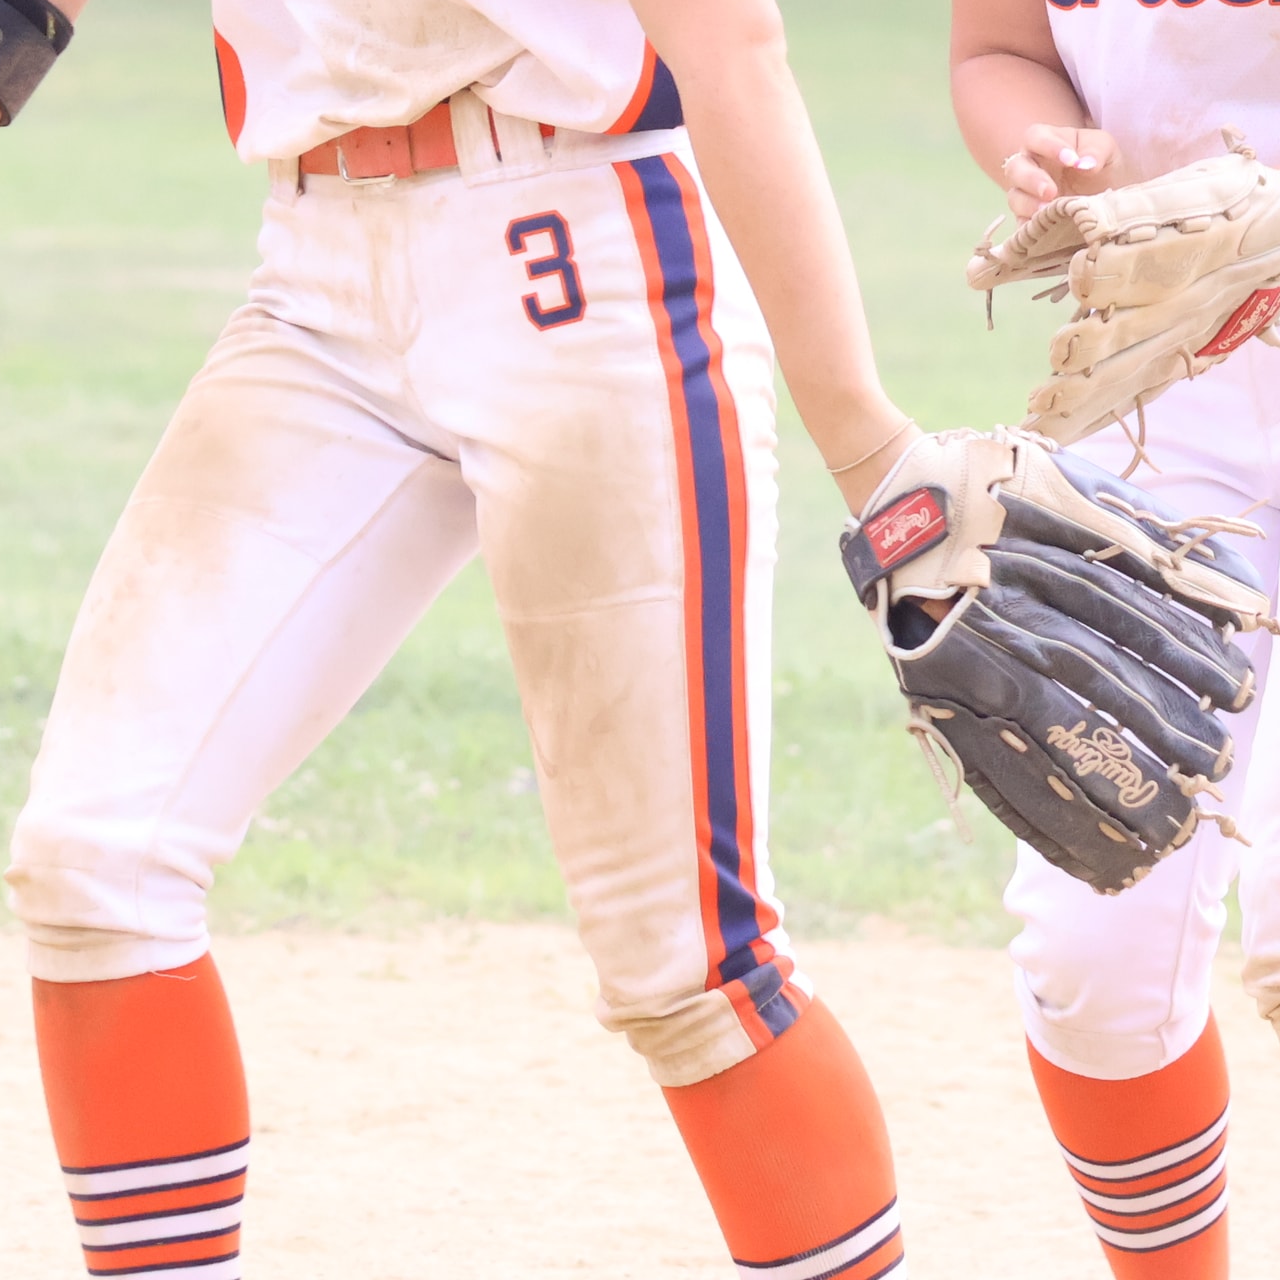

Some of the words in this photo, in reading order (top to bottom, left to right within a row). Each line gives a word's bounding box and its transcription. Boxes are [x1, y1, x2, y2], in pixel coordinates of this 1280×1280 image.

[505, 210, 587, 332] 3
[881, 507, 931, 549] Rawlings
[1047, 721, 1160, 808] Rawlings
